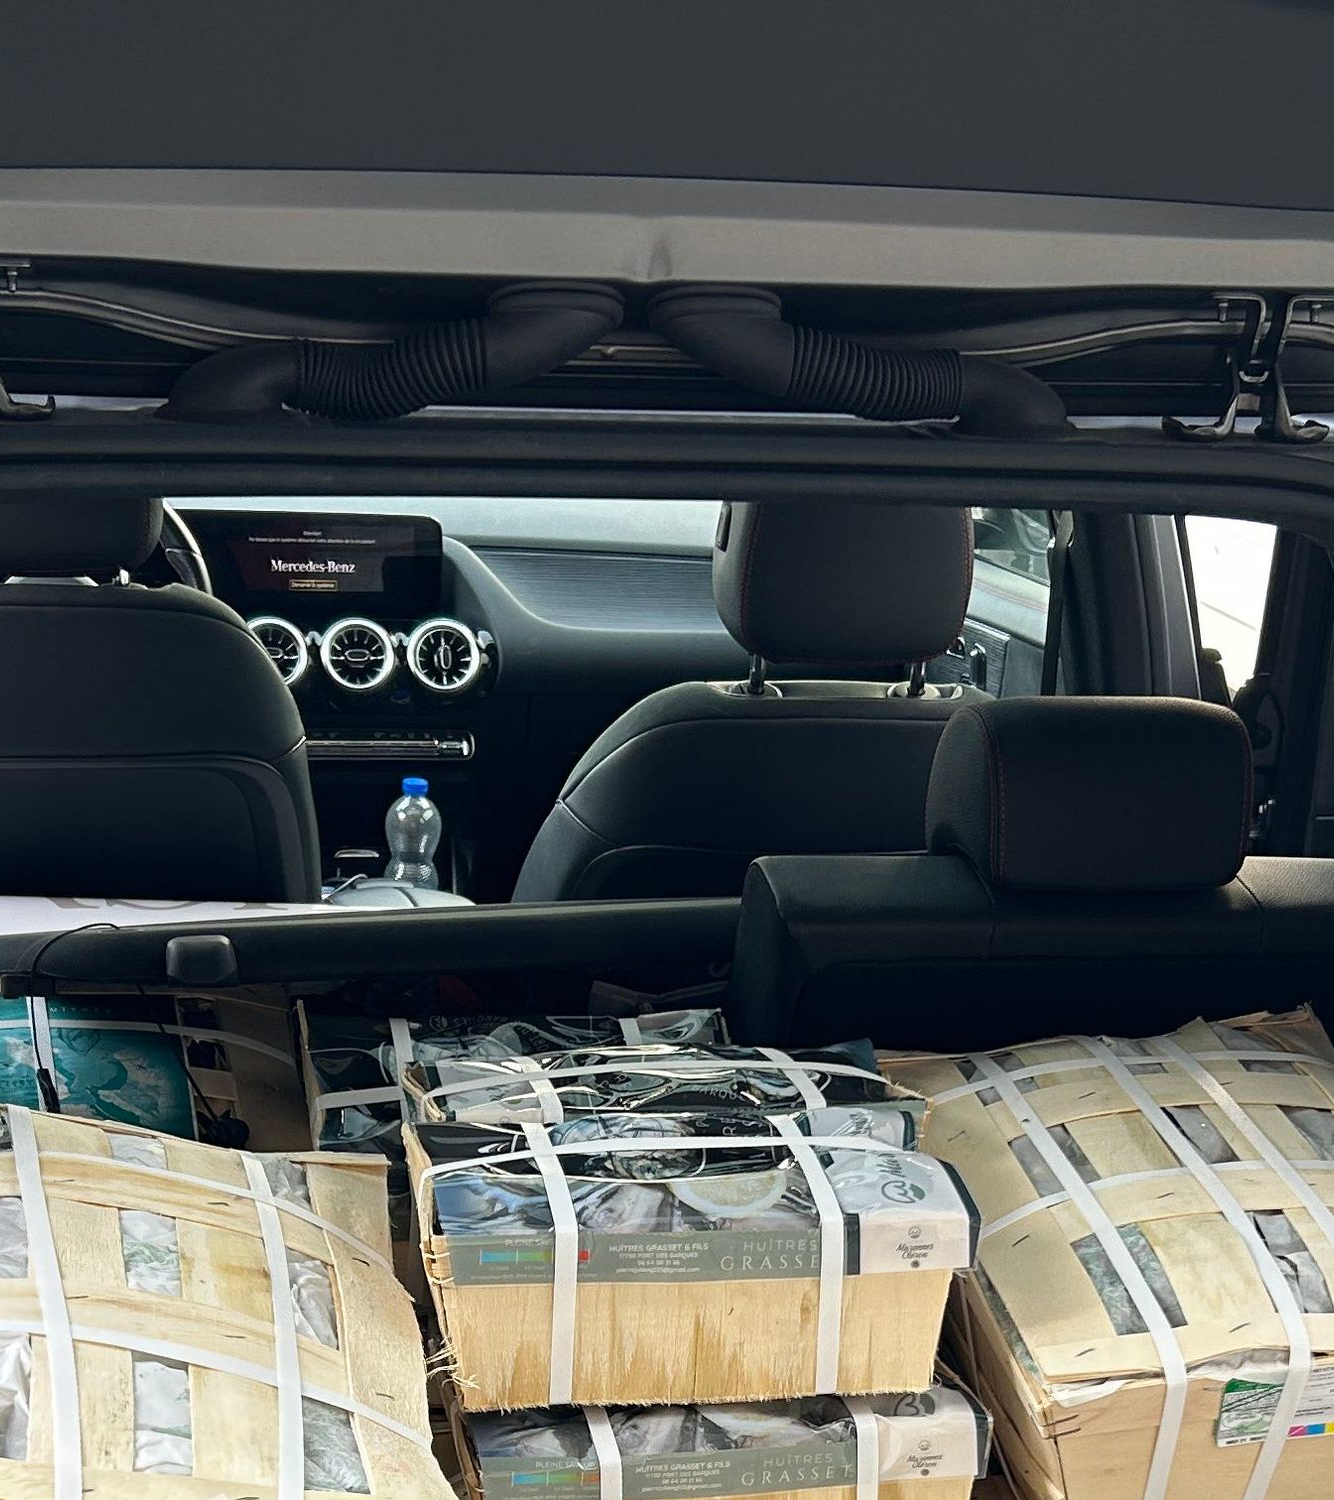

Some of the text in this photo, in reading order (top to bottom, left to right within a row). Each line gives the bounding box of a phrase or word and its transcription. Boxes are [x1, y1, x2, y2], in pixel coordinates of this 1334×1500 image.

[270, 558, 356, 573] Mercedes-Benz
[645, 1243, 682, 1251] GRASSET
[743, 1239, 817, 1251] HUÎTRES
[720, 1255, 820, 1270] GRASSE
[763, 1453, 832, 1467] HUÎTRES
[741, 1465, 851, 1486] GRASSET
